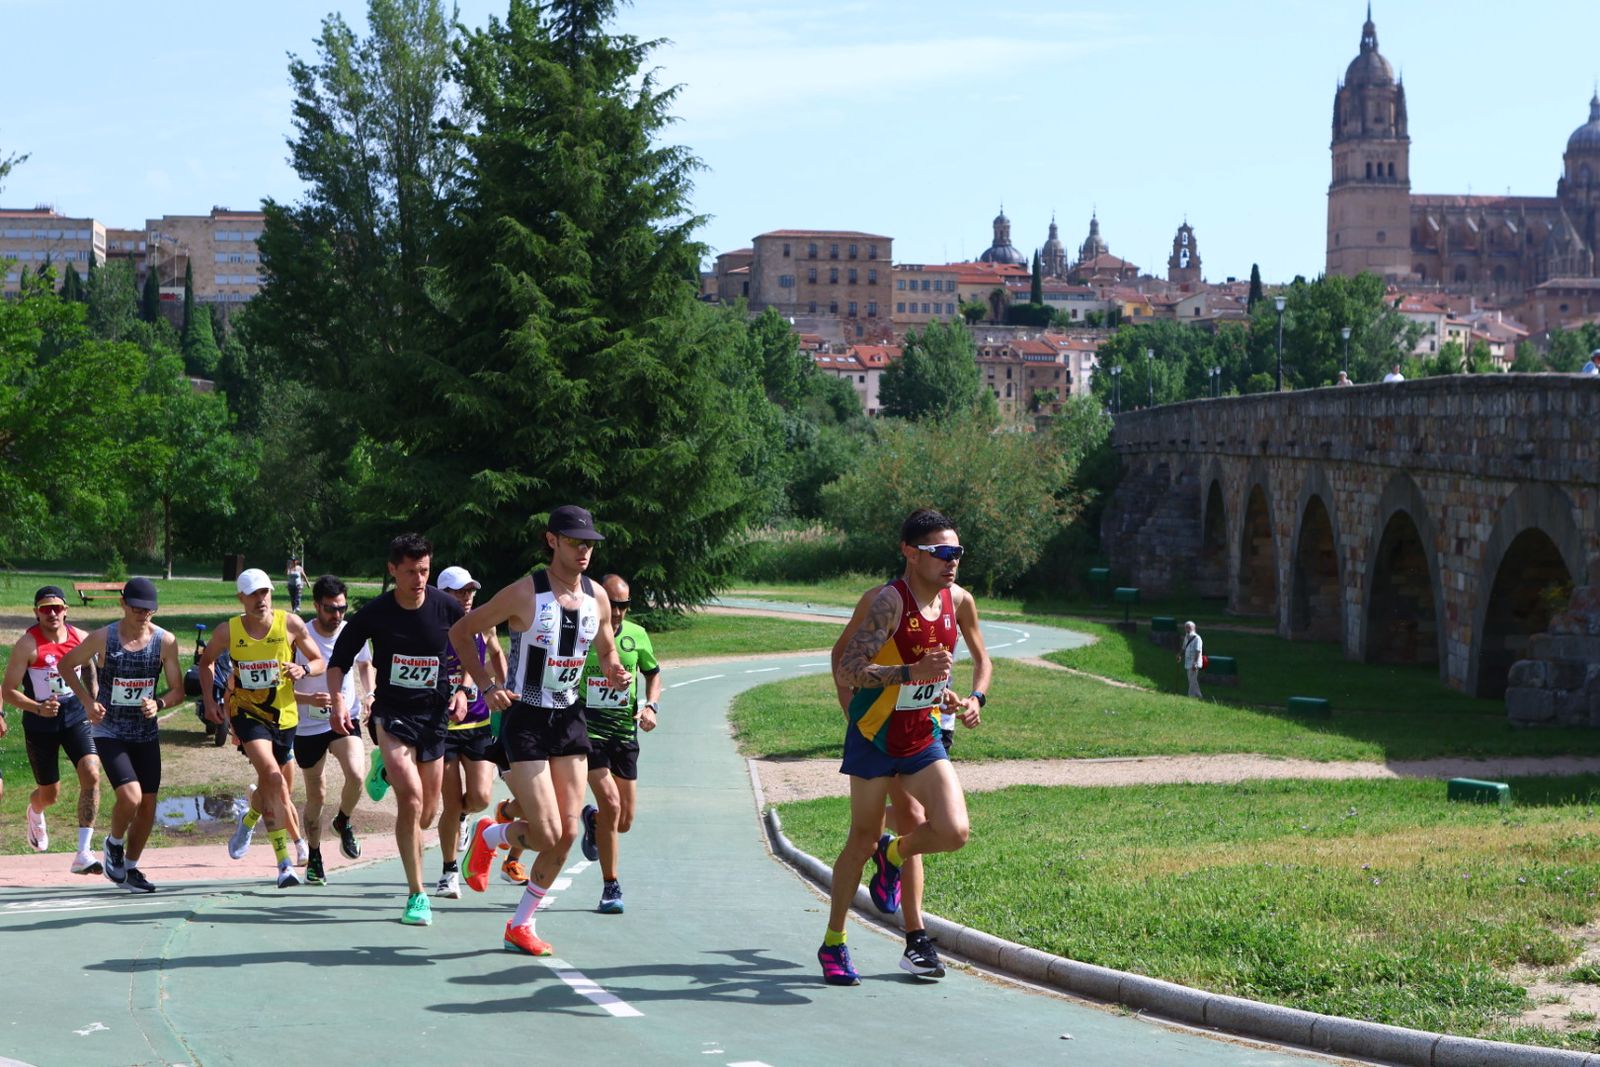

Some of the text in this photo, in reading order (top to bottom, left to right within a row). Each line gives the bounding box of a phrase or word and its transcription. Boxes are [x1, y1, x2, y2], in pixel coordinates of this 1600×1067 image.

[240, 661, 278, 670] bedunia
[393, 656, 438, 667] bedunia
[250, 670, 268, 682] 51
[399, 666, 431, 681] 247
[558, 668, 578, 683] 48
[124, 688, 143, 700] 37
[599, 688, 618, 701] 74
[912, 684, 935, 701] 40
